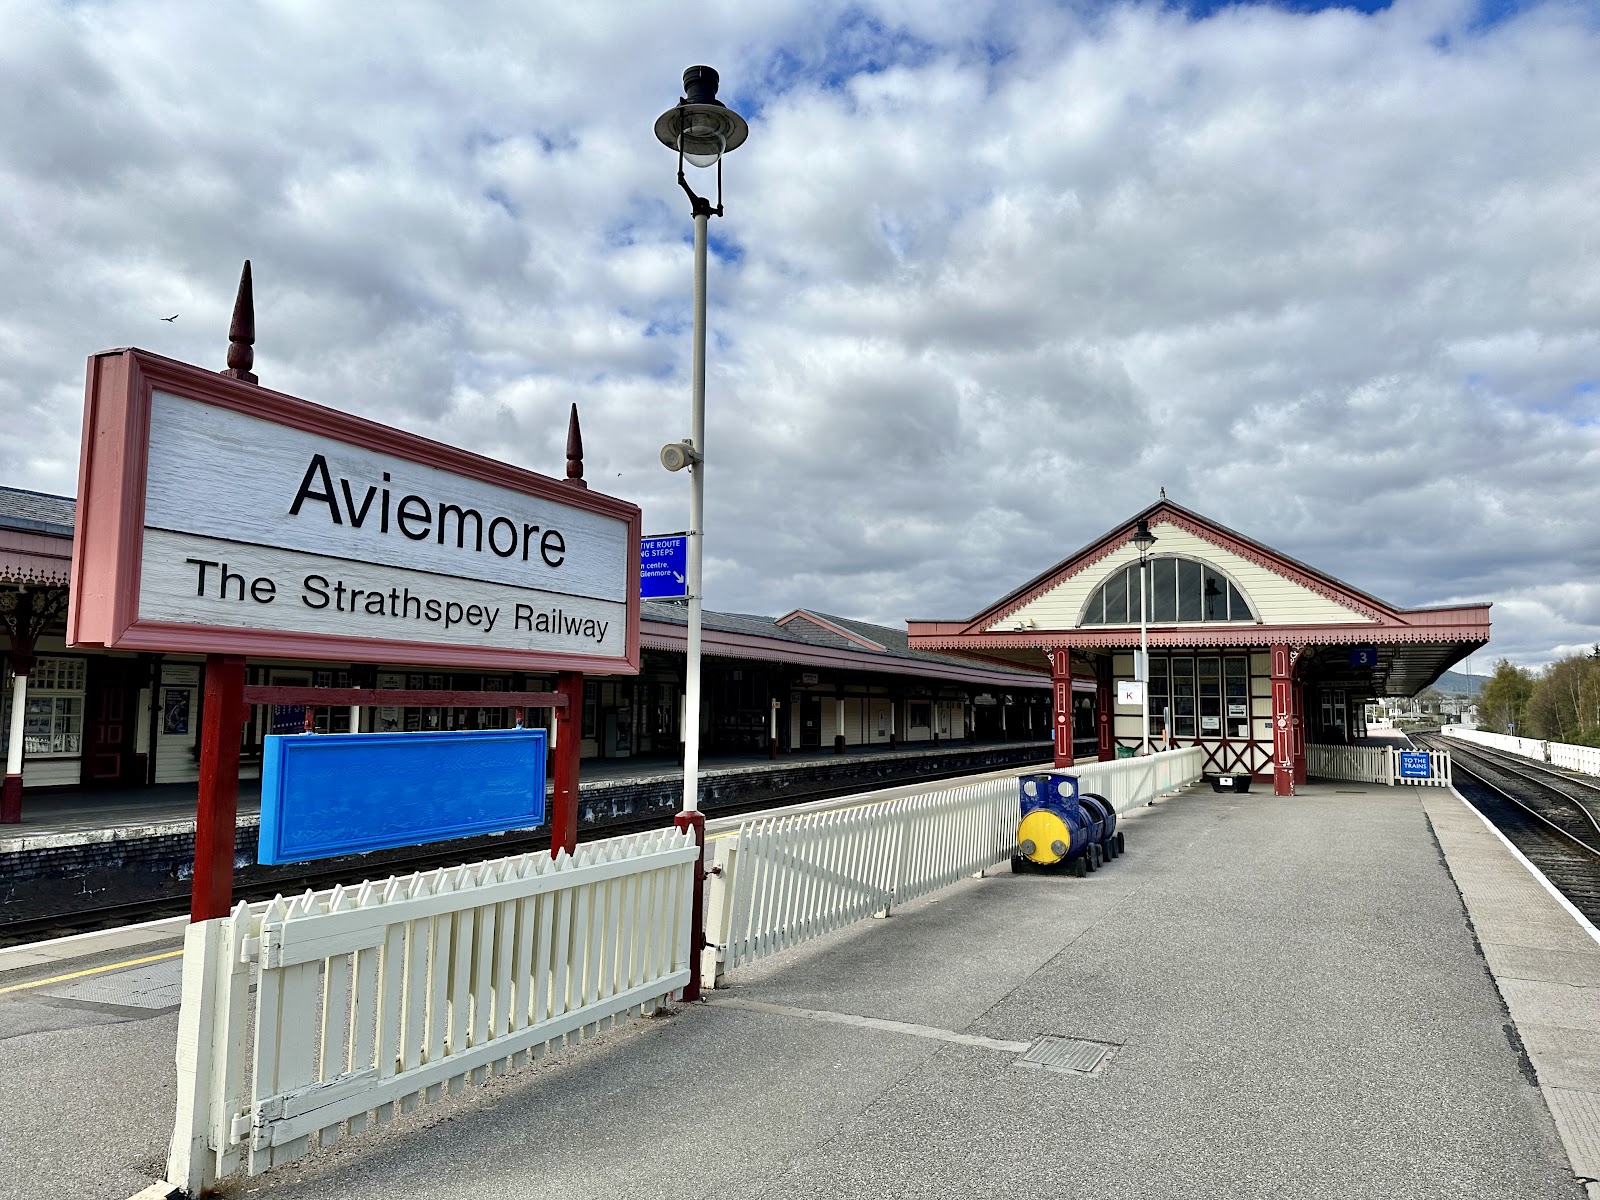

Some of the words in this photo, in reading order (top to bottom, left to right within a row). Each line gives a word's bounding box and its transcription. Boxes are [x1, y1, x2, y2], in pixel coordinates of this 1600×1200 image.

[289, 453, 566, 568] Aviemore
[186, 558, 277, 604] The
[302, 575, 500, 633] Strathspey
[514, 603, 609, 643] Railway
[1360, 652, 1367, 663] 3
